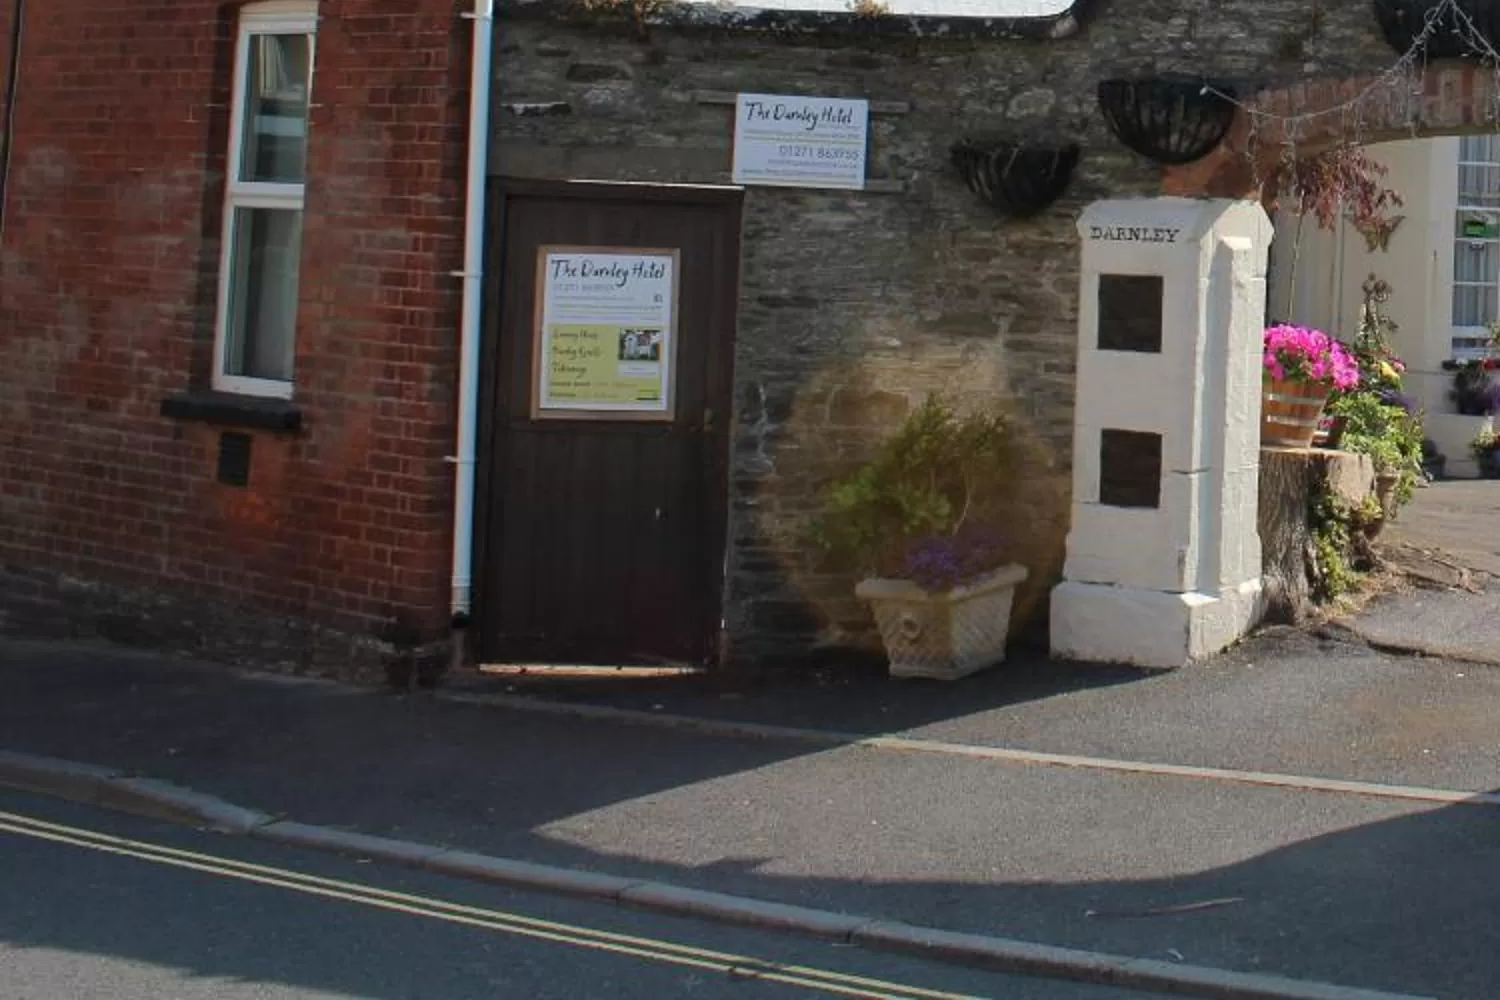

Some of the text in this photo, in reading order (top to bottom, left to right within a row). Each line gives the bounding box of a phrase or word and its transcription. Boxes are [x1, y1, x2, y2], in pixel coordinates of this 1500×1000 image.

[744, 101, 853, 131] The Darnley Hotel
[1089, 225, 1180, 243] DARNLEY
[551, 259, 665, 288] The Darnley Hotel
